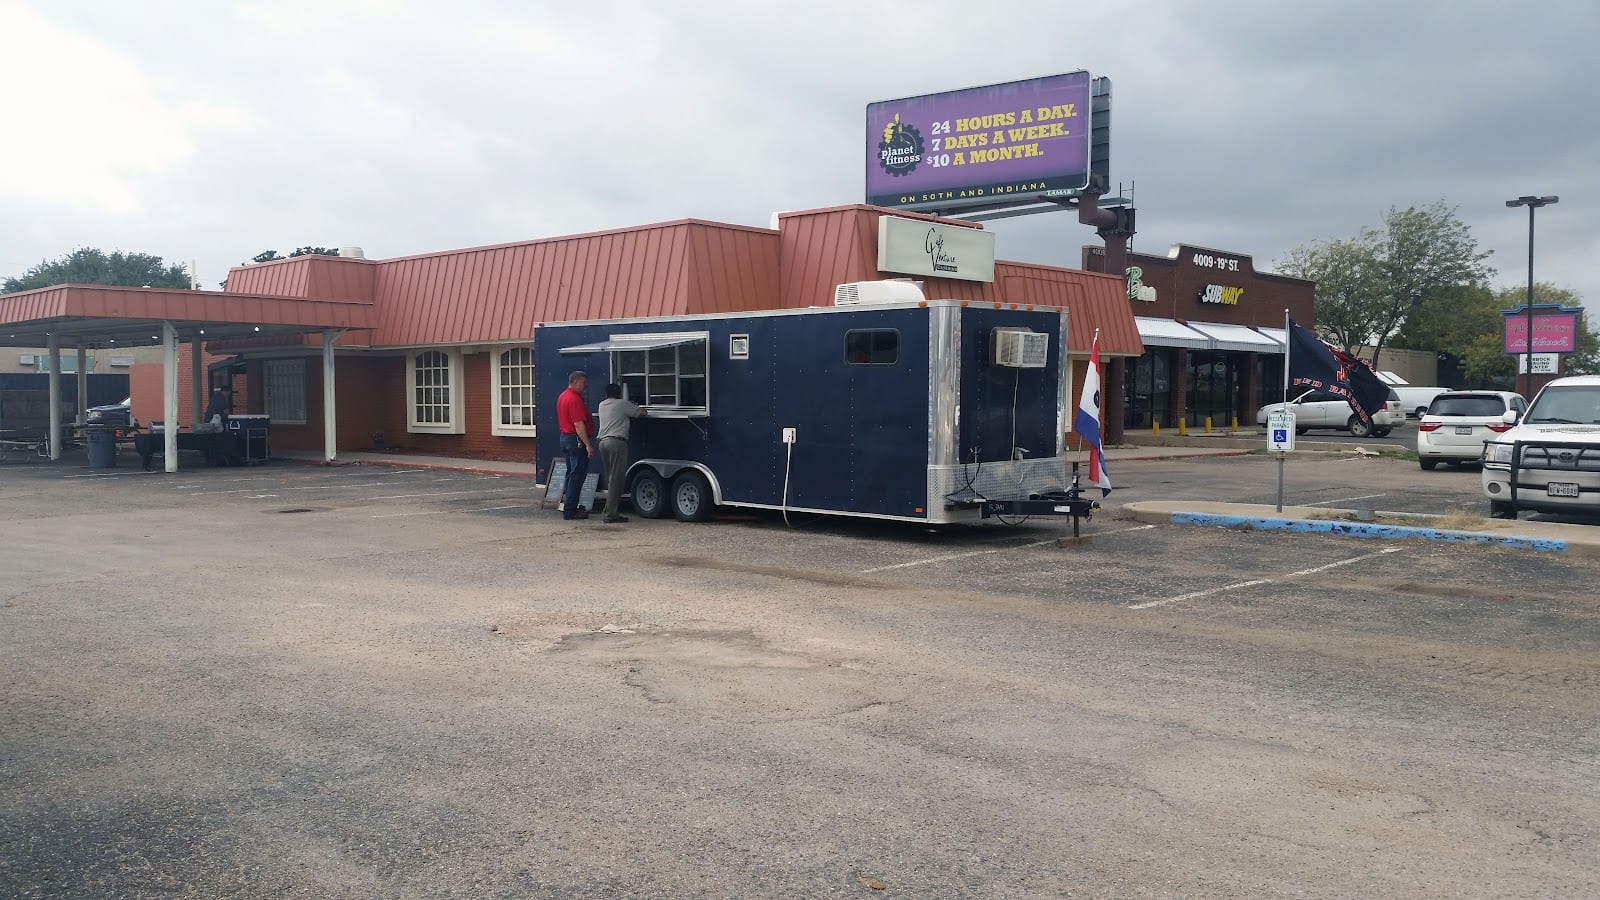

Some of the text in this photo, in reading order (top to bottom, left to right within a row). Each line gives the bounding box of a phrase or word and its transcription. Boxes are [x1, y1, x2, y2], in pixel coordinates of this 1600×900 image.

[932, 104, 1077, 135] 24 HOURS A DAY.
[932, 123, 1070, 151] 7 DAYS A WEEK.
[881, 146, 914, 160] planet
[886, 154, 921, 165] fitness
[927, 143, 1044, 168] $10 A MONTH.
[922, 192, 953, 201] 50TH
[960, 189, 984, 197] AND
[991, 182, 1046, 194] INDIANA
[1228, 259, 1240, 272] ST.
[1201, 283, 1244, 305] SUBWAY
[1292, 377, 1323, 388] RED
